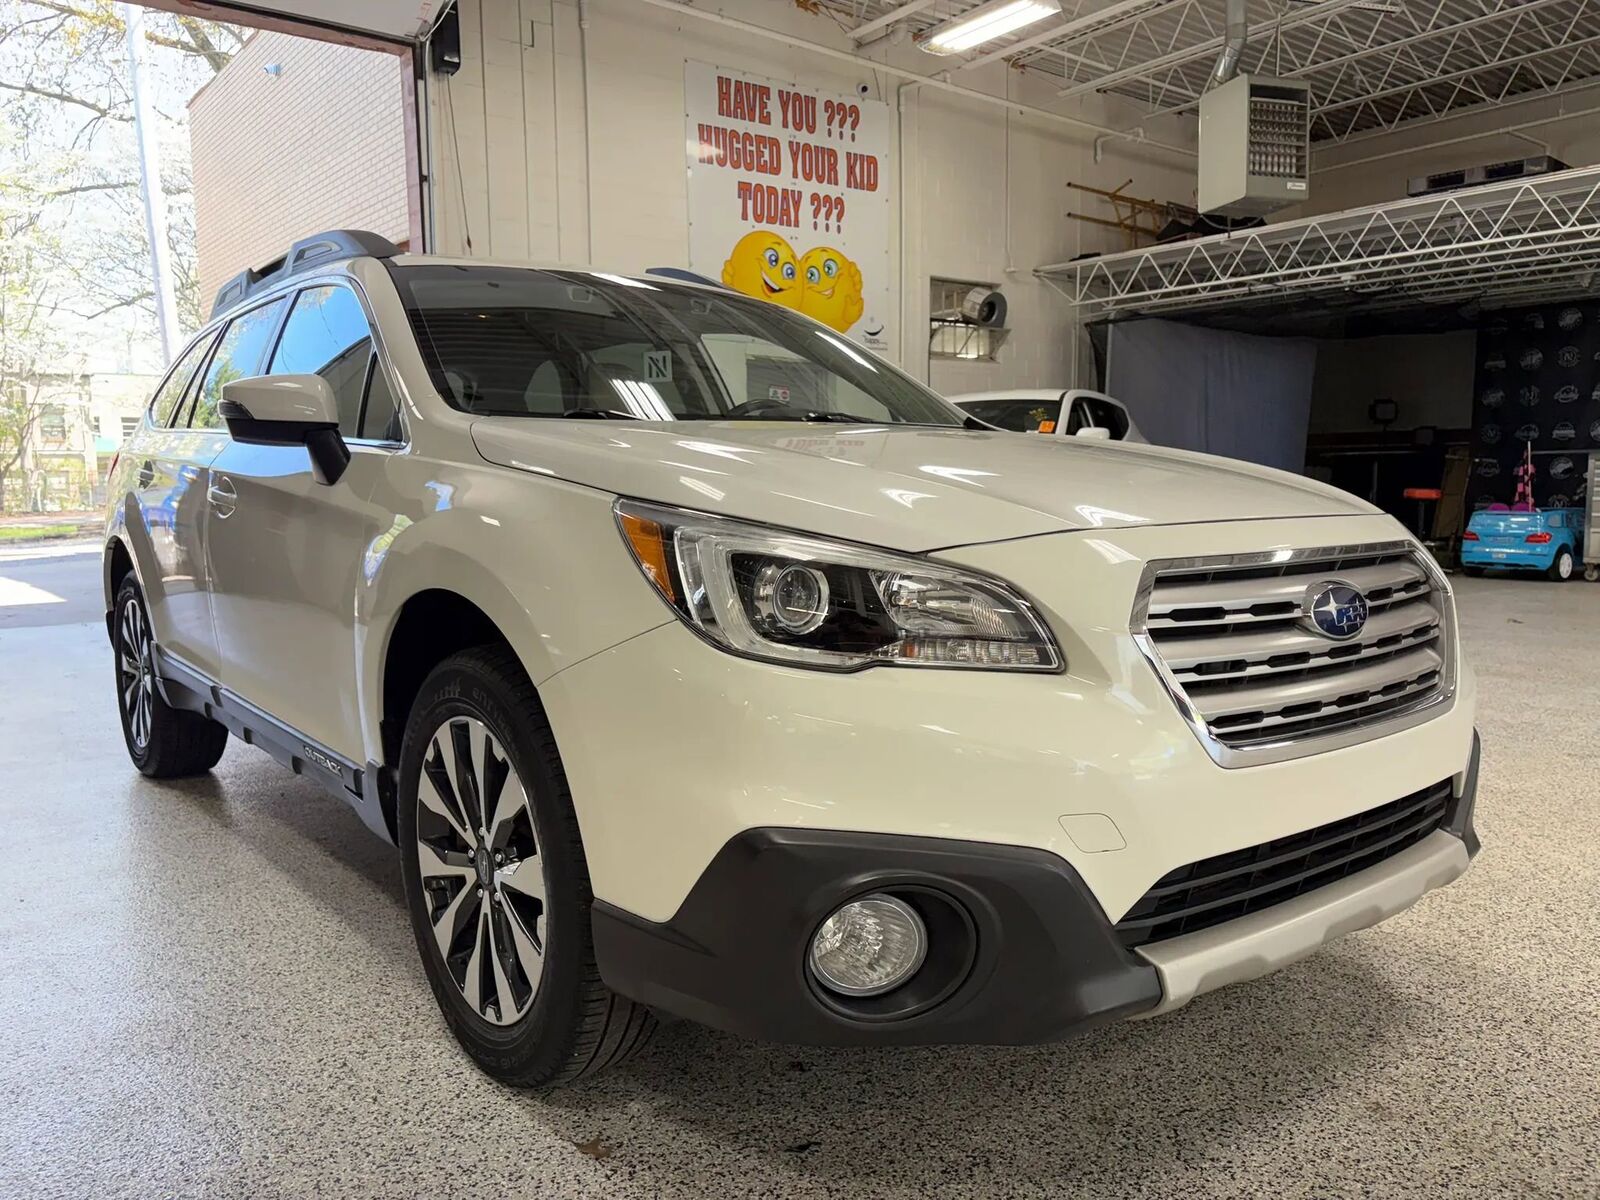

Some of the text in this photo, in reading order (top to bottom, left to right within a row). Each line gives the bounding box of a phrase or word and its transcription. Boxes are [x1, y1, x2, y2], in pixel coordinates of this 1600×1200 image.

[717, 76, 860, 143] HAVE YOU ???
[697, 123, 879, 192] HUGGED YOUR KID
[737, 180, 845, 235] TODAY ???
